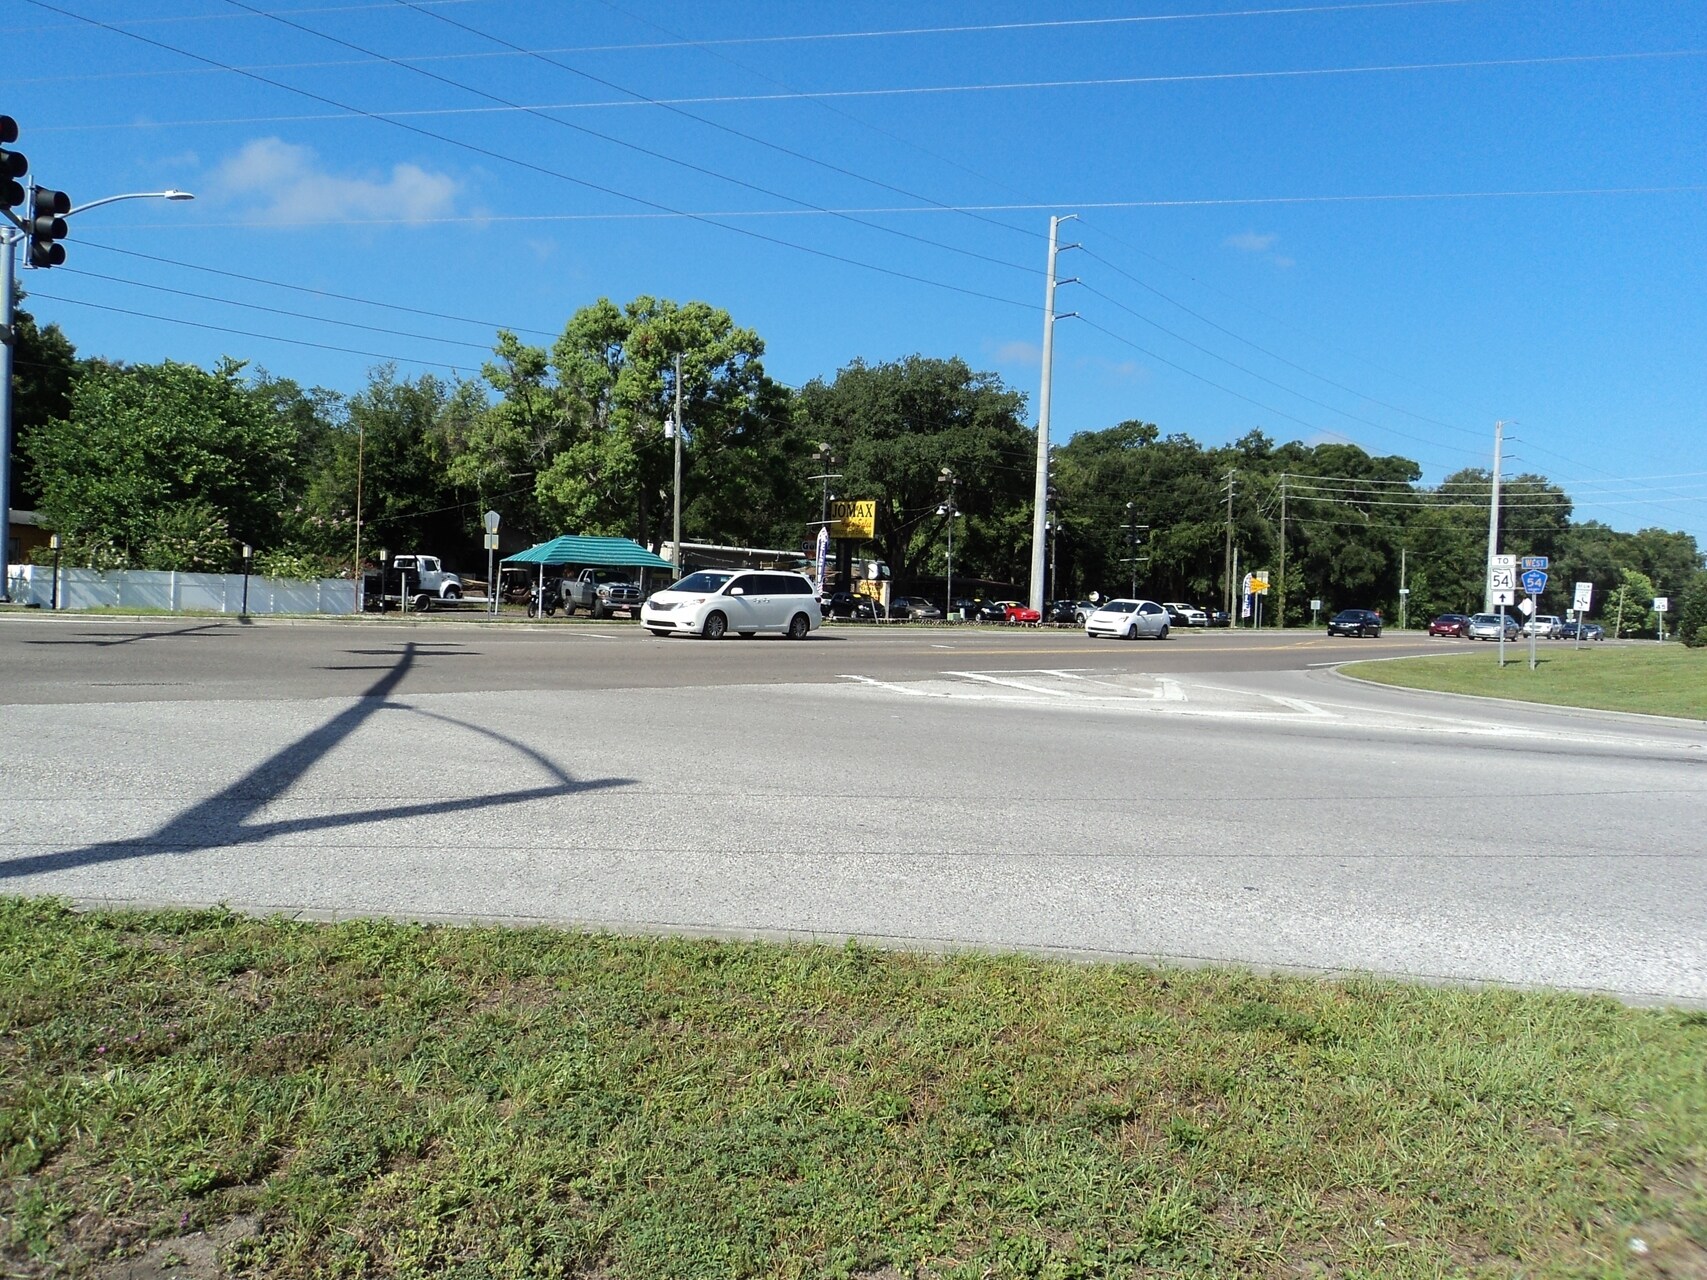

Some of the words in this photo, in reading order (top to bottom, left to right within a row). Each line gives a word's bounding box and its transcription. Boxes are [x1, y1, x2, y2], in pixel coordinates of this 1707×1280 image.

[832, 503, 873, 518] JOMAX
[1525, 558, 1544, 567] WEST
[1493, 575, 1508, 587] 54
[1527, 577, 1542, 588] 54
